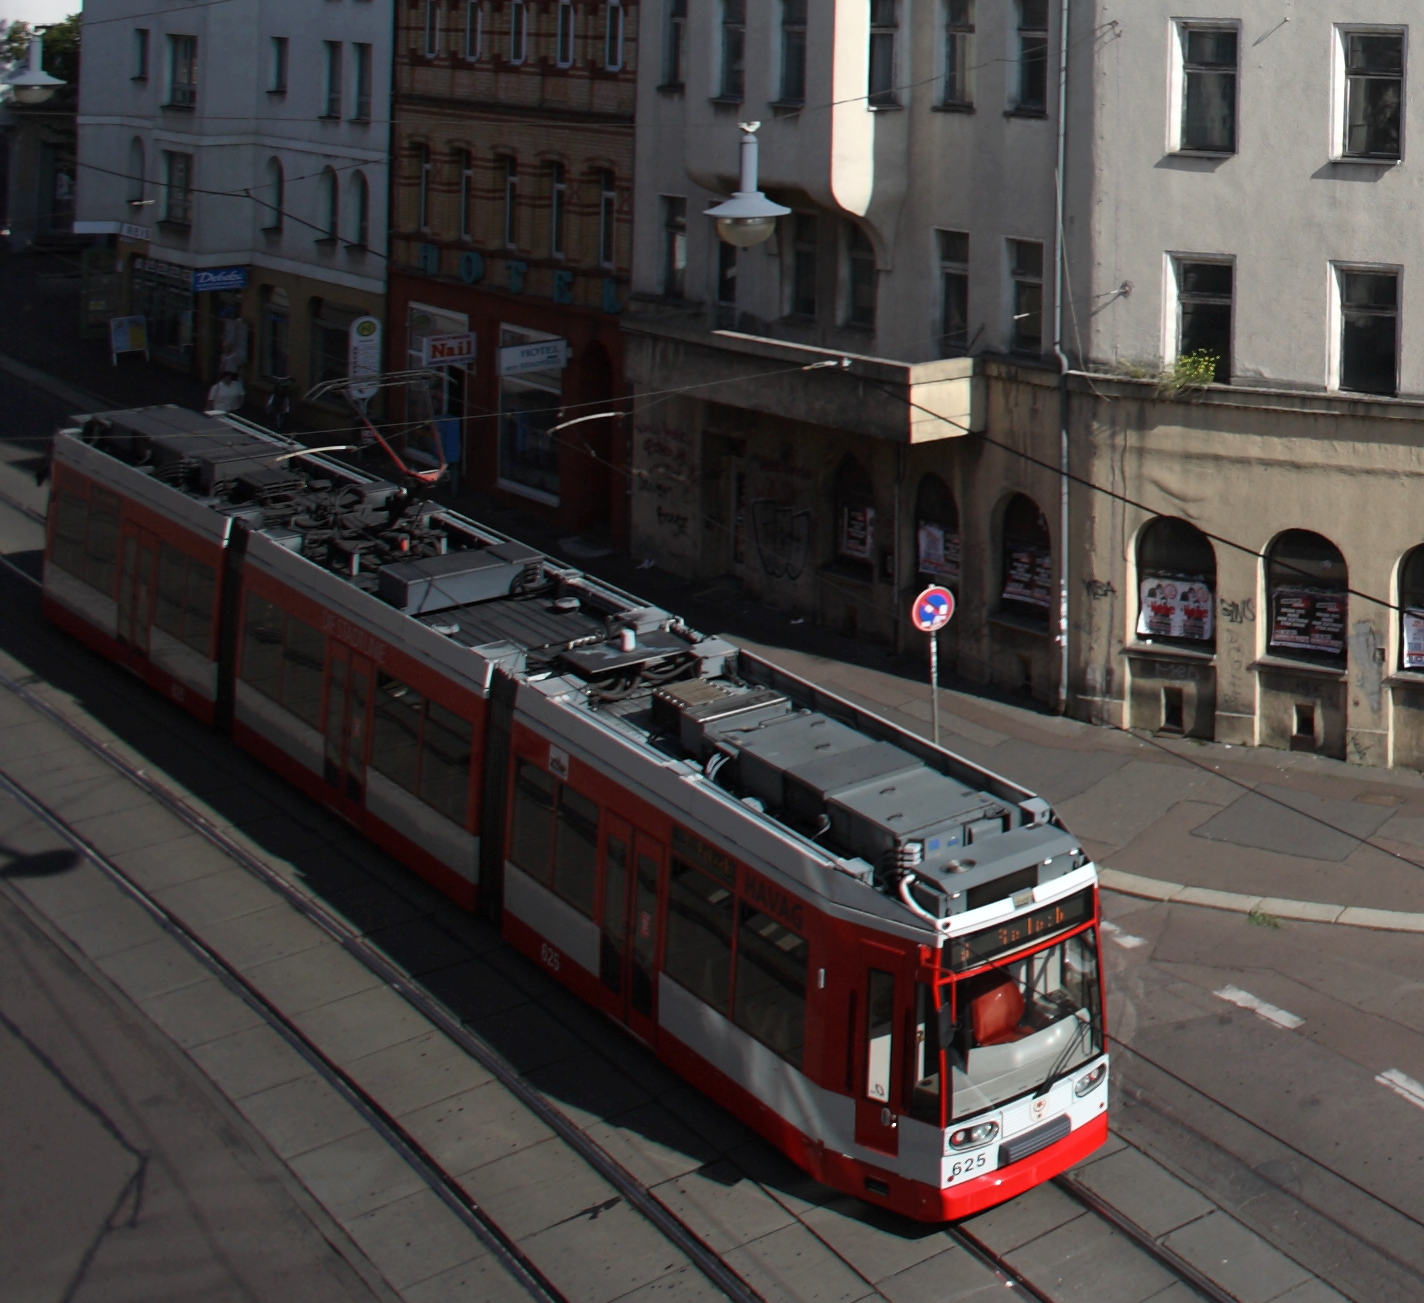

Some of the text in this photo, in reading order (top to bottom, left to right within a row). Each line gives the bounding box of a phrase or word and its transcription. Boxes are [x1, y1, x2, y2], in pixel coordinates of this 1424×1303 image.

[418, 243, 623, 314] HOTEL
[432, 340, 472, 359] Nail
[520, 345, 559, 358] HOTEL
[744, 873, 804, 931] HAVAG
[541, 942, 560, 972] 625
[952, 1152, 986, 1177] 625
